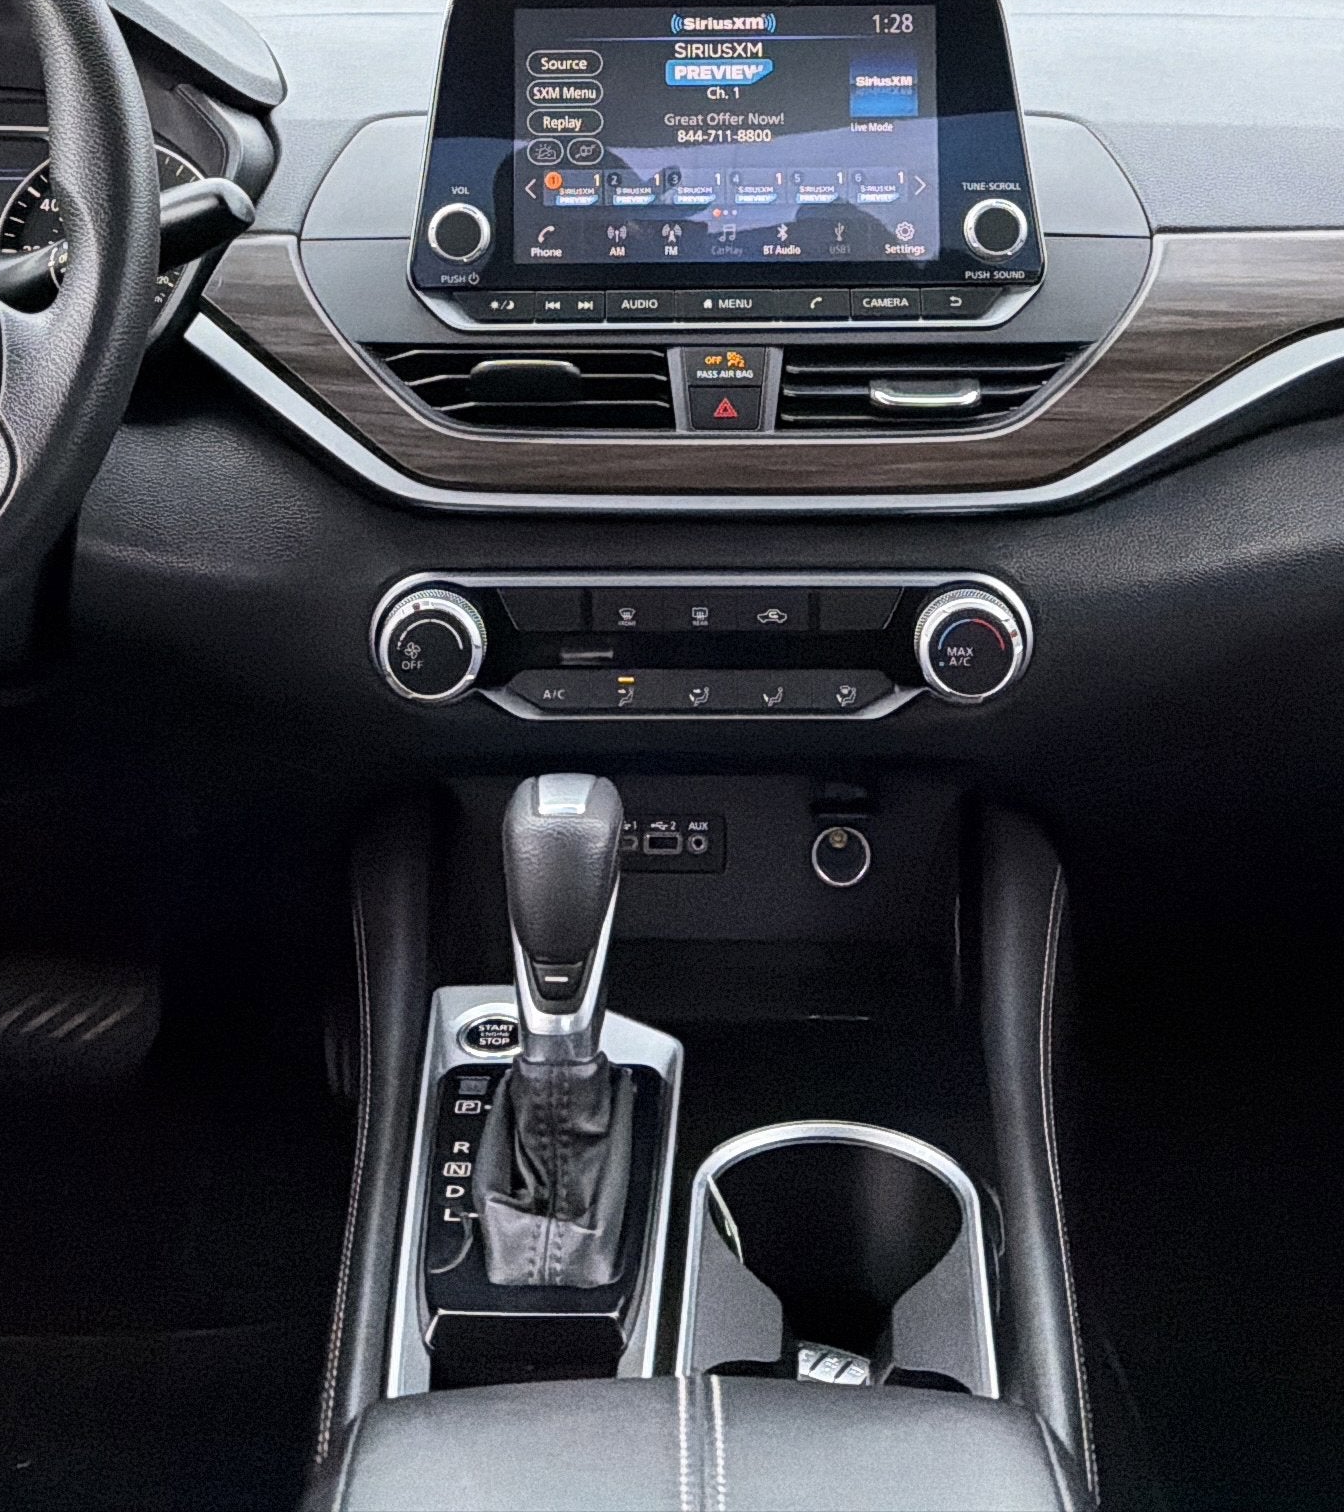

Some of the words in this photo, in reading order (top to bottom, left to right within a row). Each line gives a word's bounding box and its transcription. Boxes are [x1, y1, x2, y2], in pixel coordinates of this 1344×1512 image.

[872, 14, 913, 34] 1:28
[674, 43, 763, 58] SIRIUSXM
[540, 57, 588, 70] Source
[674, 65, 764, 80] PREVIEW
[856, 76, 912, 87] SiriusXM
[533, 87, 560, 100] SXM
[562, 87, 597, 99] Menu
[707, 88, 729, 100] Ch.
[733, 87, 740, 99] 1
[543, 116, 582, 132] Replay
[664, 113, 703, 126] Great
[706, 112, 744, 126] Offer
[748, 112, 785, 125] Now!
[850, 123, 868, 133] Live
[868, 122, 894, 132] Mode
[677, 130, 772, 143] 844-711-8800
[593, 173, 600, 186] 1
[654, 173, 660, 186] 1
[714, 173, 721, 186] 1
[775, 172, 783, 185] 1
[836, 172, 843, 184] 1
[898, 171, 905, 184] 1
[451, 186, 470, 195] VOL
[531, 248, 563, 258] Phone
[609, 247, 626, 257] AM
[664, 246, 679, 256] FM
[711, 246, 743, 257] CarPlay
[763, 245, 774, 255] BT
[774, 245, 801, 255] Audio
[884, 244, 925, 255] Settings
[441, 274, 466, 284] PUSH
[965, 271, 990, 280] PUSH
[993, 270, 1025, 279] SOUND
[621, 299, 659, 309] AUDIO
[718, 298, 752, 309] MENU
[862, 297, 909, 308] CAMERA
[705, 355, 723, 365] OFF
[697, 370, 719, 379] PASS
[719, 370, 734, 378] AIR
[736, 370, 754, 378] BAG
[946, 647, 974, 656] MAX
[401, 660, 424, 671] OFF
[948, 657, 971, 667] A/C
[542, 689, 566, 700] A/C
[688, 821, 709, 831] AUX
[478, 1024, 514, 1032] START
[479, 1037, 511, 1046] STOP
[461, 1102, 475, 1111] P
[453, 1141, 470, 1154] R
[449, 1164, 465, 1175] N
[446, 1185, 465, 1198] D
[444, 1209, 461, 1222] L
